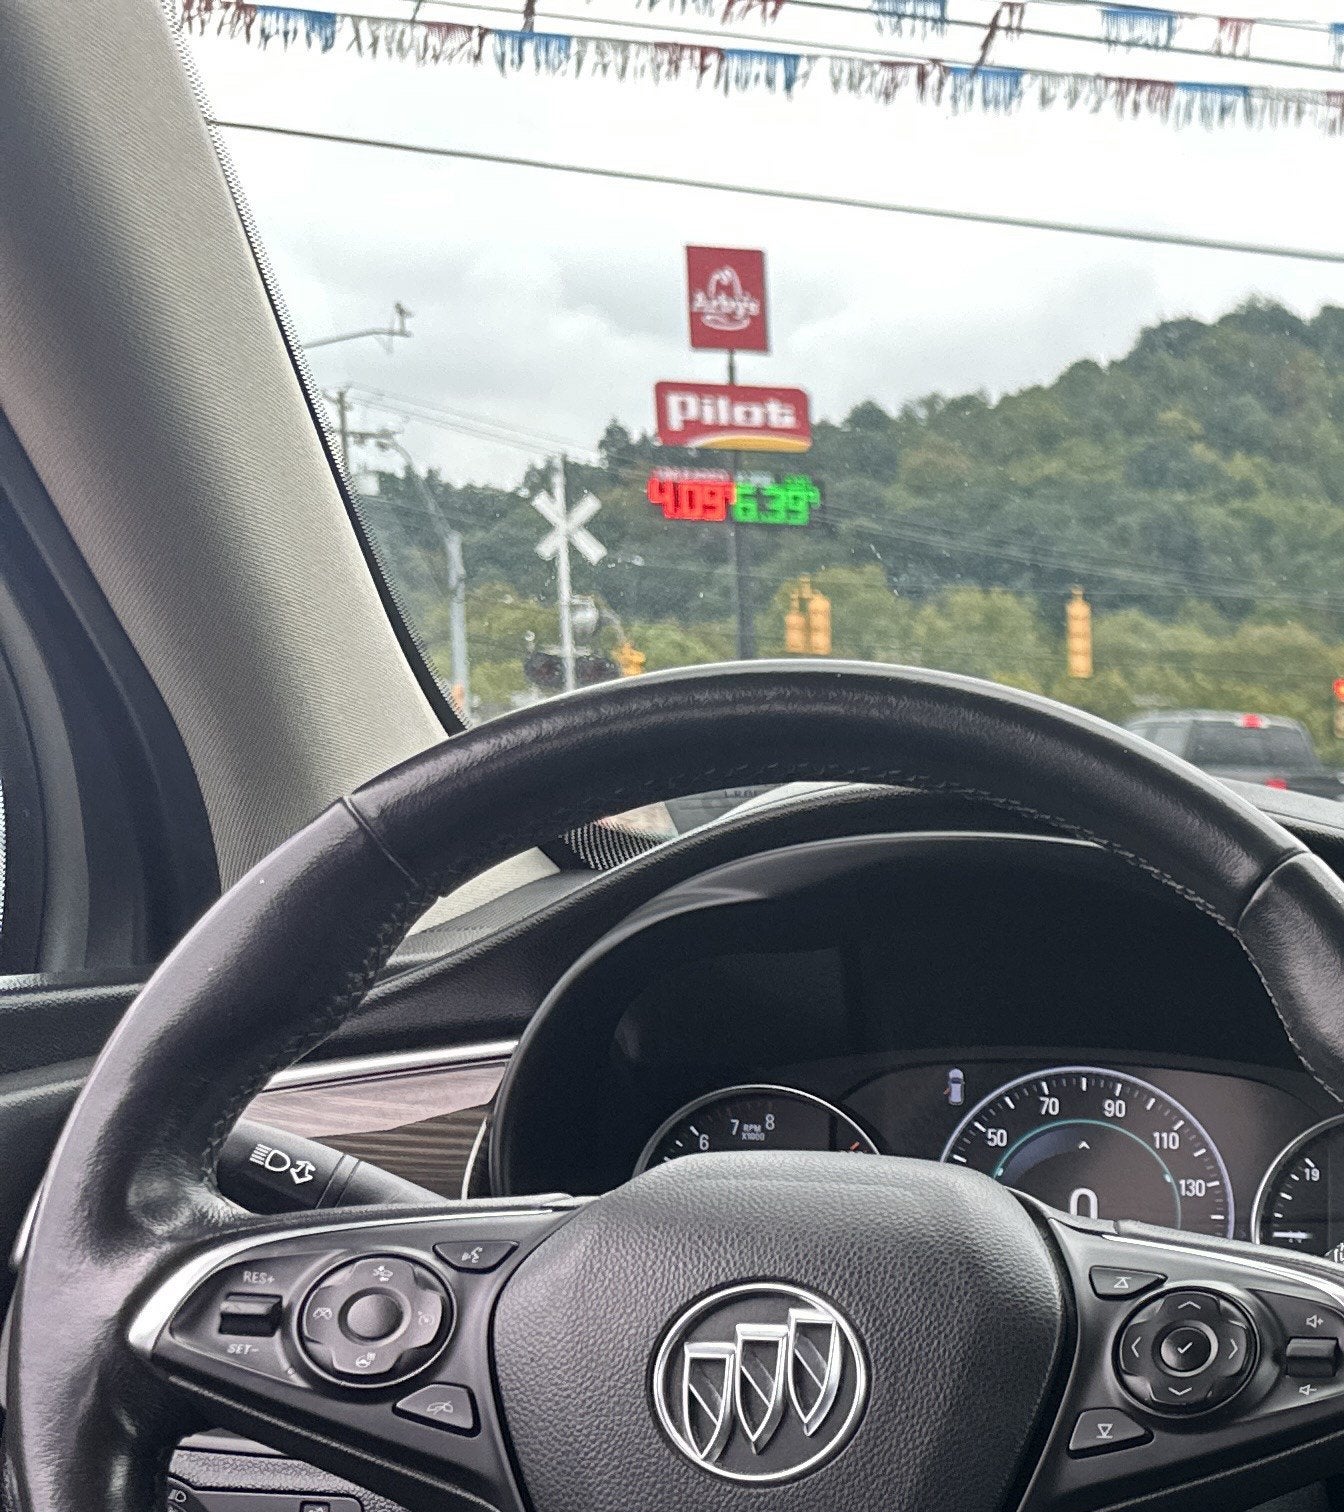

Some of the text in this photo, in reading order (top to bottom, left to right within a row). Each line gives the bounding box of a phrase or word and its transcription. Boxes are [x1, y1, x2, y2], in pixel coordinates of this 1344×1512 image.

[665, 391, 798, 432] Pilot
[1040, 1097, 1060, 1116] 70
[1104, 1100, 1126, 1119] 90
[730, 1118, 740, 1136] 7
[765, 1113, 775, 1130] 8
[699, 1134, 710, 1150] 6
[986, 1129, 1008, 1147] 50
[1153, 1131, 1180, 1150] 110
[1303, 1168, 1321, 1183] 19
[1179, 1178, 1206, 1198] 130
[242, 1270, 276, 1286] RES+
